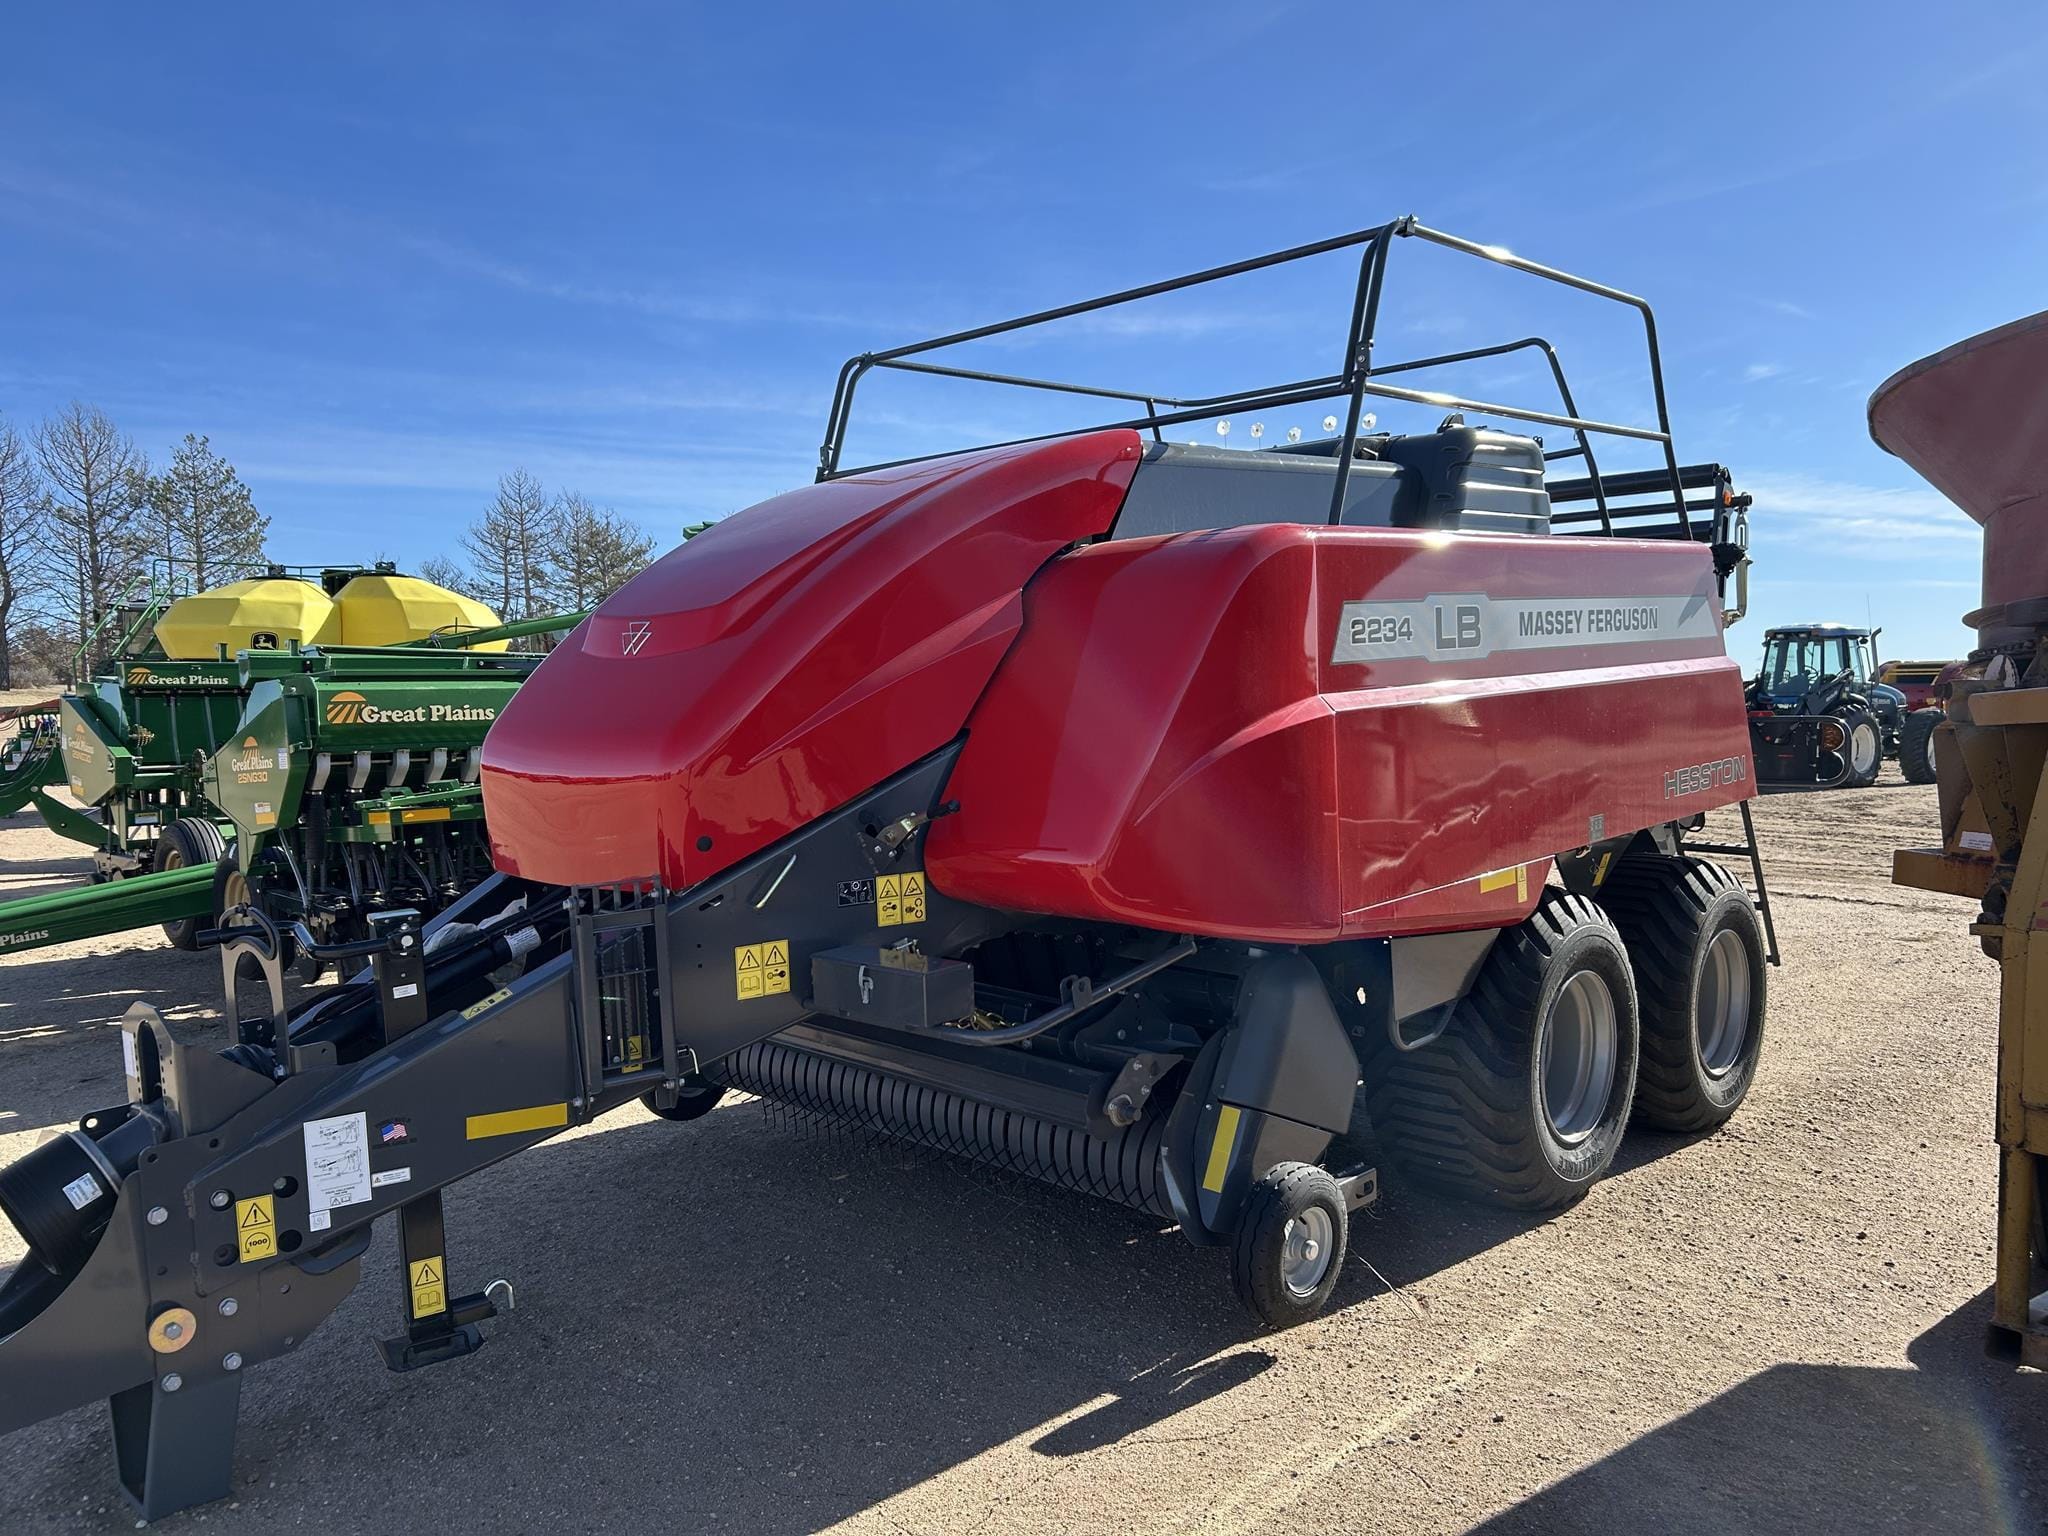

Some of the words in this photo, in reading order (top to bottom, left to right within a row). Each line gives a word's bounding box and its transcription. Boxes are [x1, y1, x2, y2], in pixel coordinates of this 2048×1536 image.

[1349, 615, 1414, 645] 2234
[1433, 604, 1482, 650] LB
[1518, 608, 1583, 637] MASSEY
[1586, 606, 1659, 634] FERGUSON
[147, 674, 187, 685] Great
[188, 674, 229, 685] Plains
[361, 704, 426, 723] Great
[429, 704, 495, 722] Plains
[231, 757, 251, 772] Great
[251, 755, 273, 770] Plains
[1663, 754, 1747, 800] HESSTON
[0, 929, 49, 947] Plains
[248, 1238, 268, 1247] 1000
